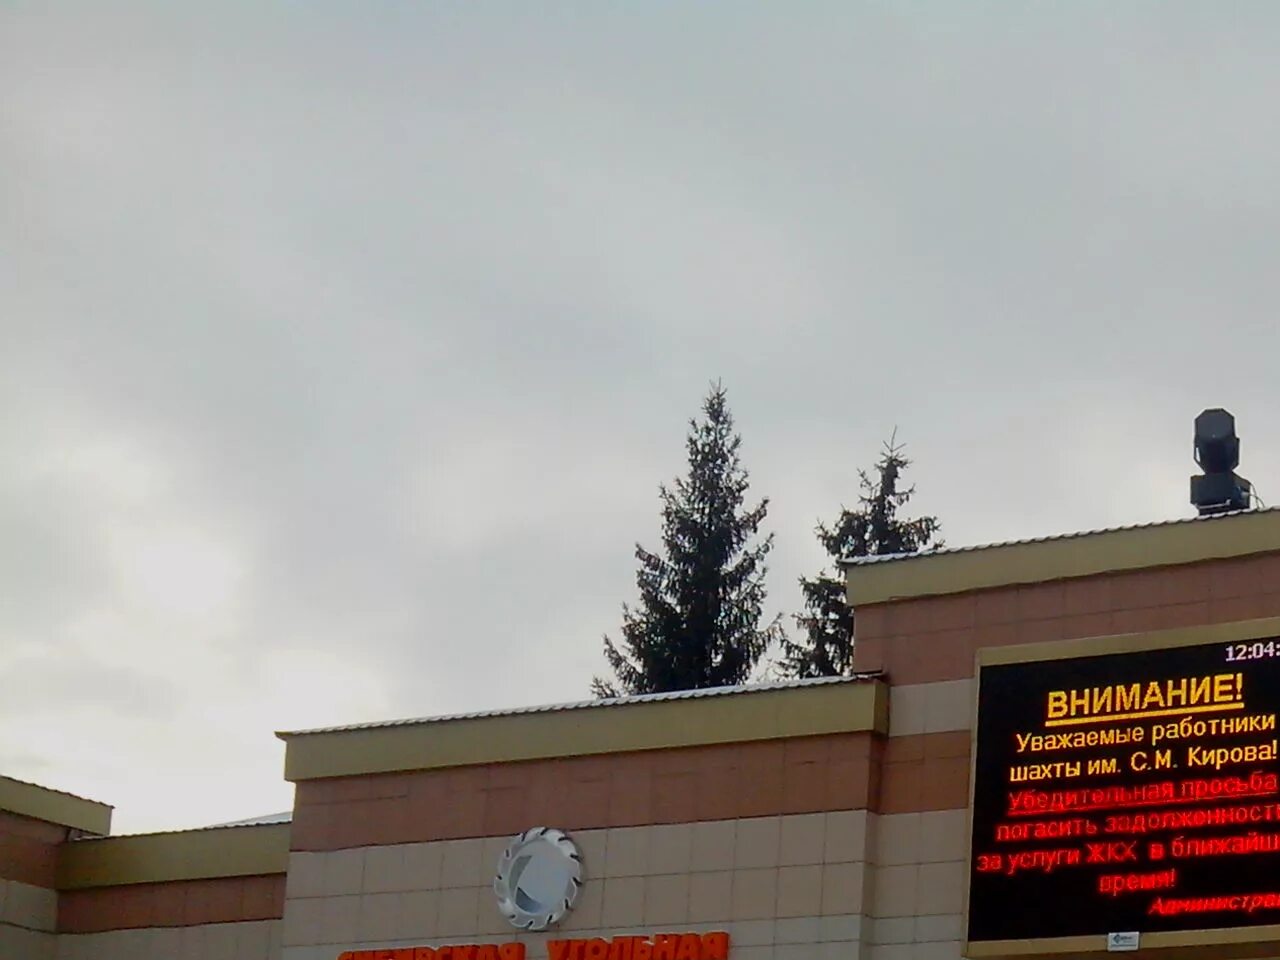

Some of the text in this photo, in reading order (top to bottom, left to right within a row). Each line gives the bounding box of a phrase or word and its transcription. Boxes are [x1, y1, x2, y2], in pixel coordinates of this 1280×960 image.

[1047, 673, 1244, 719] ВНИМАНИЕ!
[1015, 712, 1276, 753] Уважаемые работники
[1009, 760, 1081, 782] шахты
[1088, 757, 1121, 776] им.
[1187, 740, 1278, 771] Кирова!
[1009, 771, 1278, 815] Убедительная просьба
[996, 818, 1097, 842] погасить
[977, 854, 1002, 872] за
[1008, 849, 1080, 874] услуги
[1088, 840, 1138, 863] ЖКХ
[1149, 844, 1164, 860] в
[1099, 869, 1176, 895] время!
